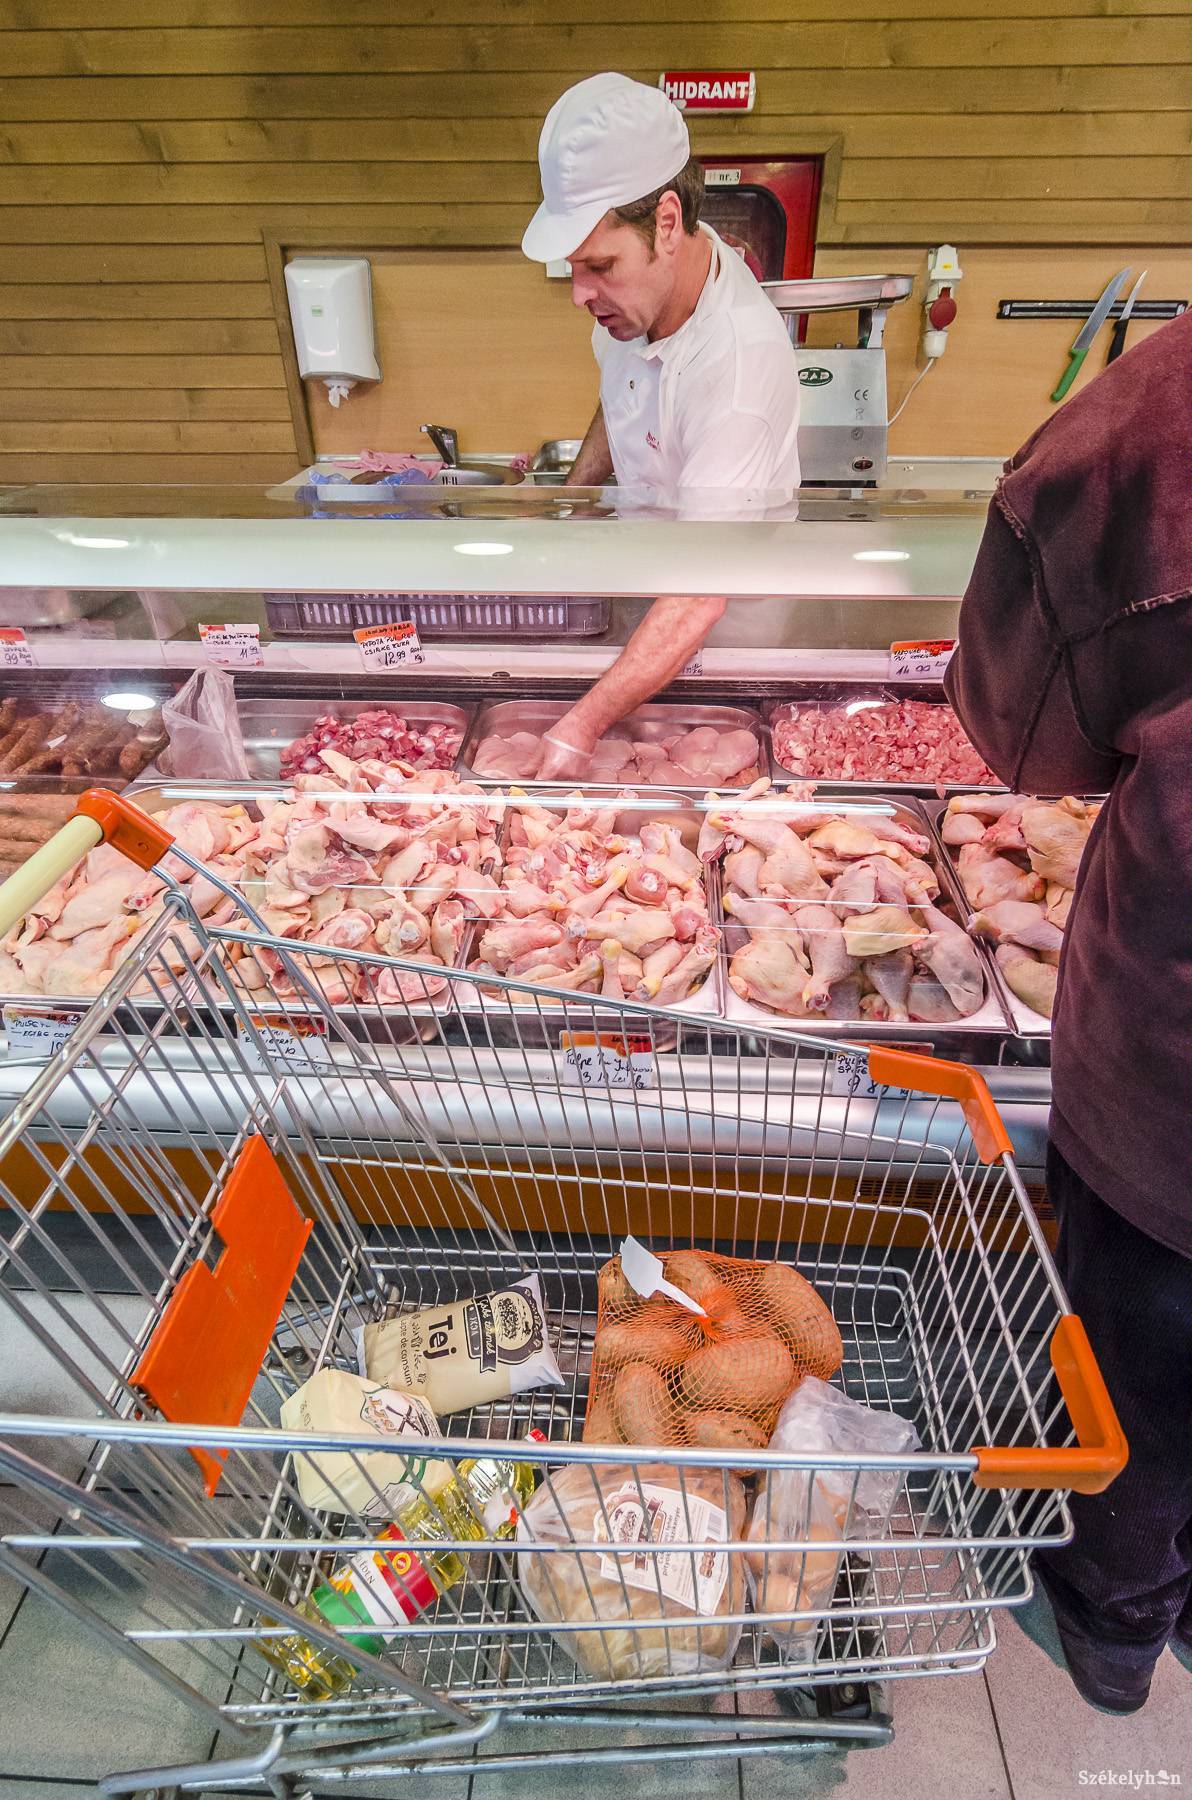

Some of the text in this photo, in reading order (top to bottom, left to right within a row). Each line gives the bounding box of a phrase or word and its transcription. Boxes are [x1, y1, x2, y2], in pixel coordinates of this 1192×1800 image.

[665, 81, 749, 99] HIDRANT
[400, 1337, 407, 1348] de
[423, 1315, 457, 1359] Tej
[400, 1348, 413, 1387] consum
